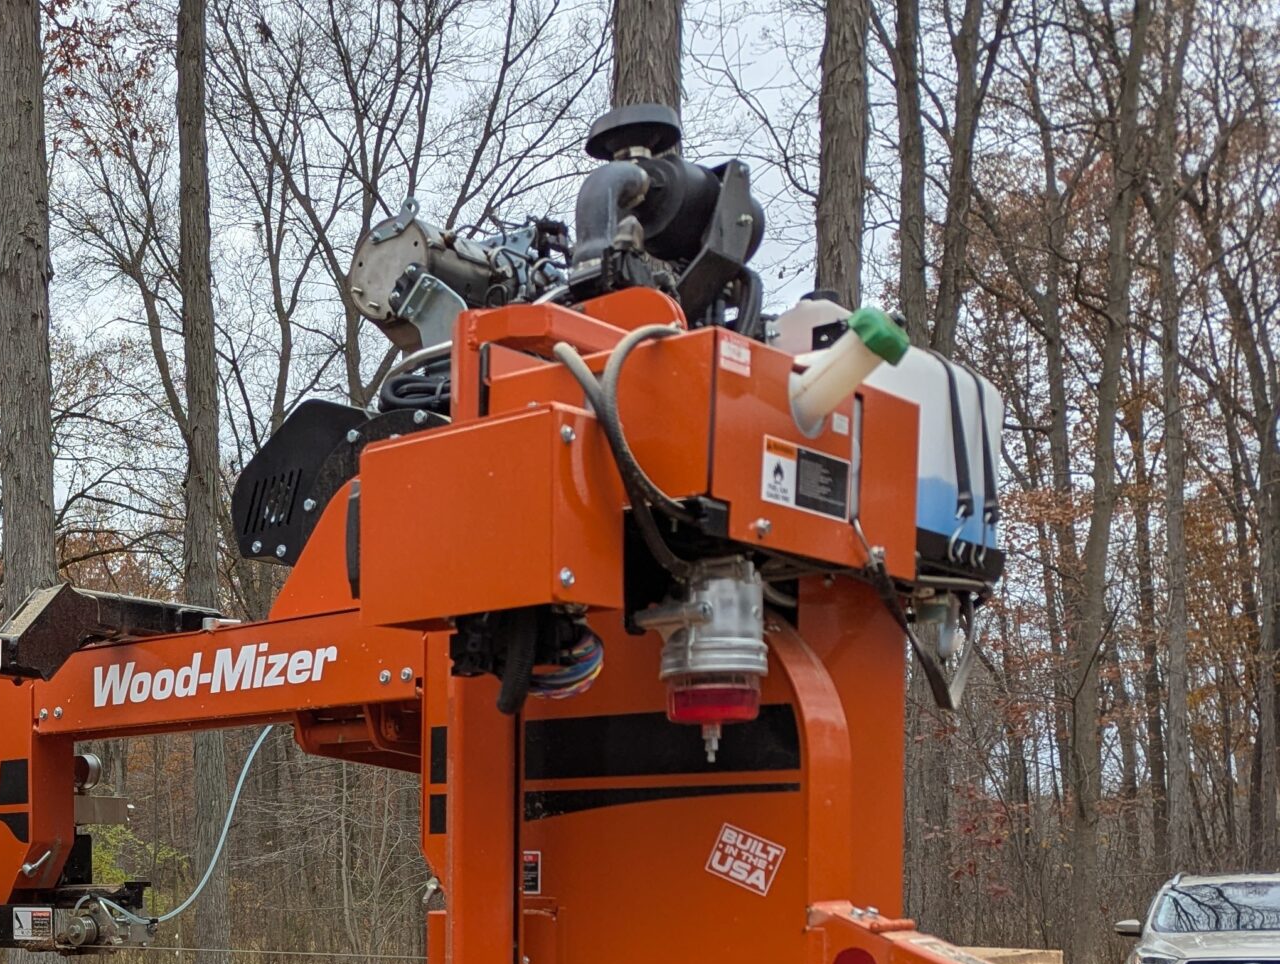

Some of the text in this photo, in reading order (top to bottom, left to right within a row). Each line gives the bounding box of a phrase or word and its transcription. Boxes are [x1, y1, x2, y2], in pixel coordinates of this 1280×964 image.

[93, 642, 338, 708] Wood-Mizer
[721, 827, 781, 862] BUILT
[724, 844, 768, 870] IN THE
[711, 850, 766, 891] USA
